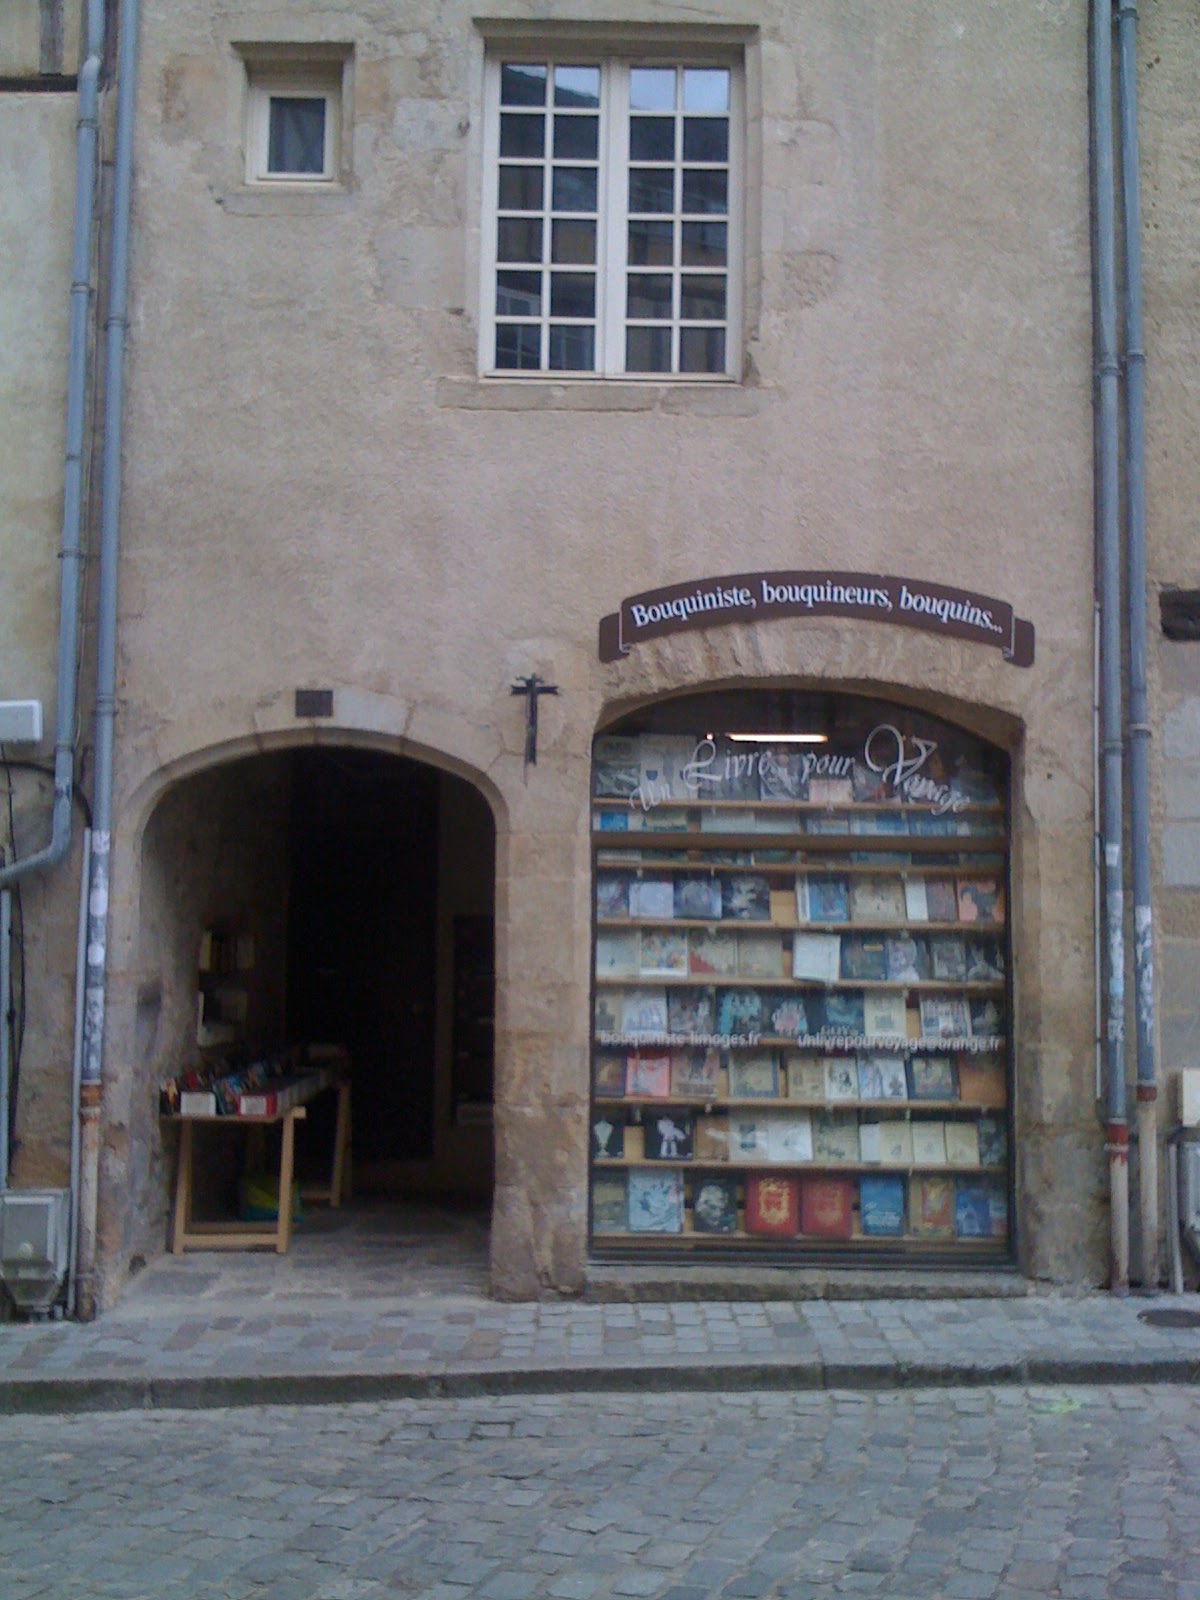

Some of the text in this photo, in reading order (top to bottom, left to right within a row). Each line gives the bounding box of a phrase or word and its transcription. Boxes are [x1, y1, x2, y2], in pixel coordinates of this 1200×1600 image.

[631, 579, 1003, 633] Bouquiniste, bouquineurs, bouquins...
[801, 750, 854, 784] pour
